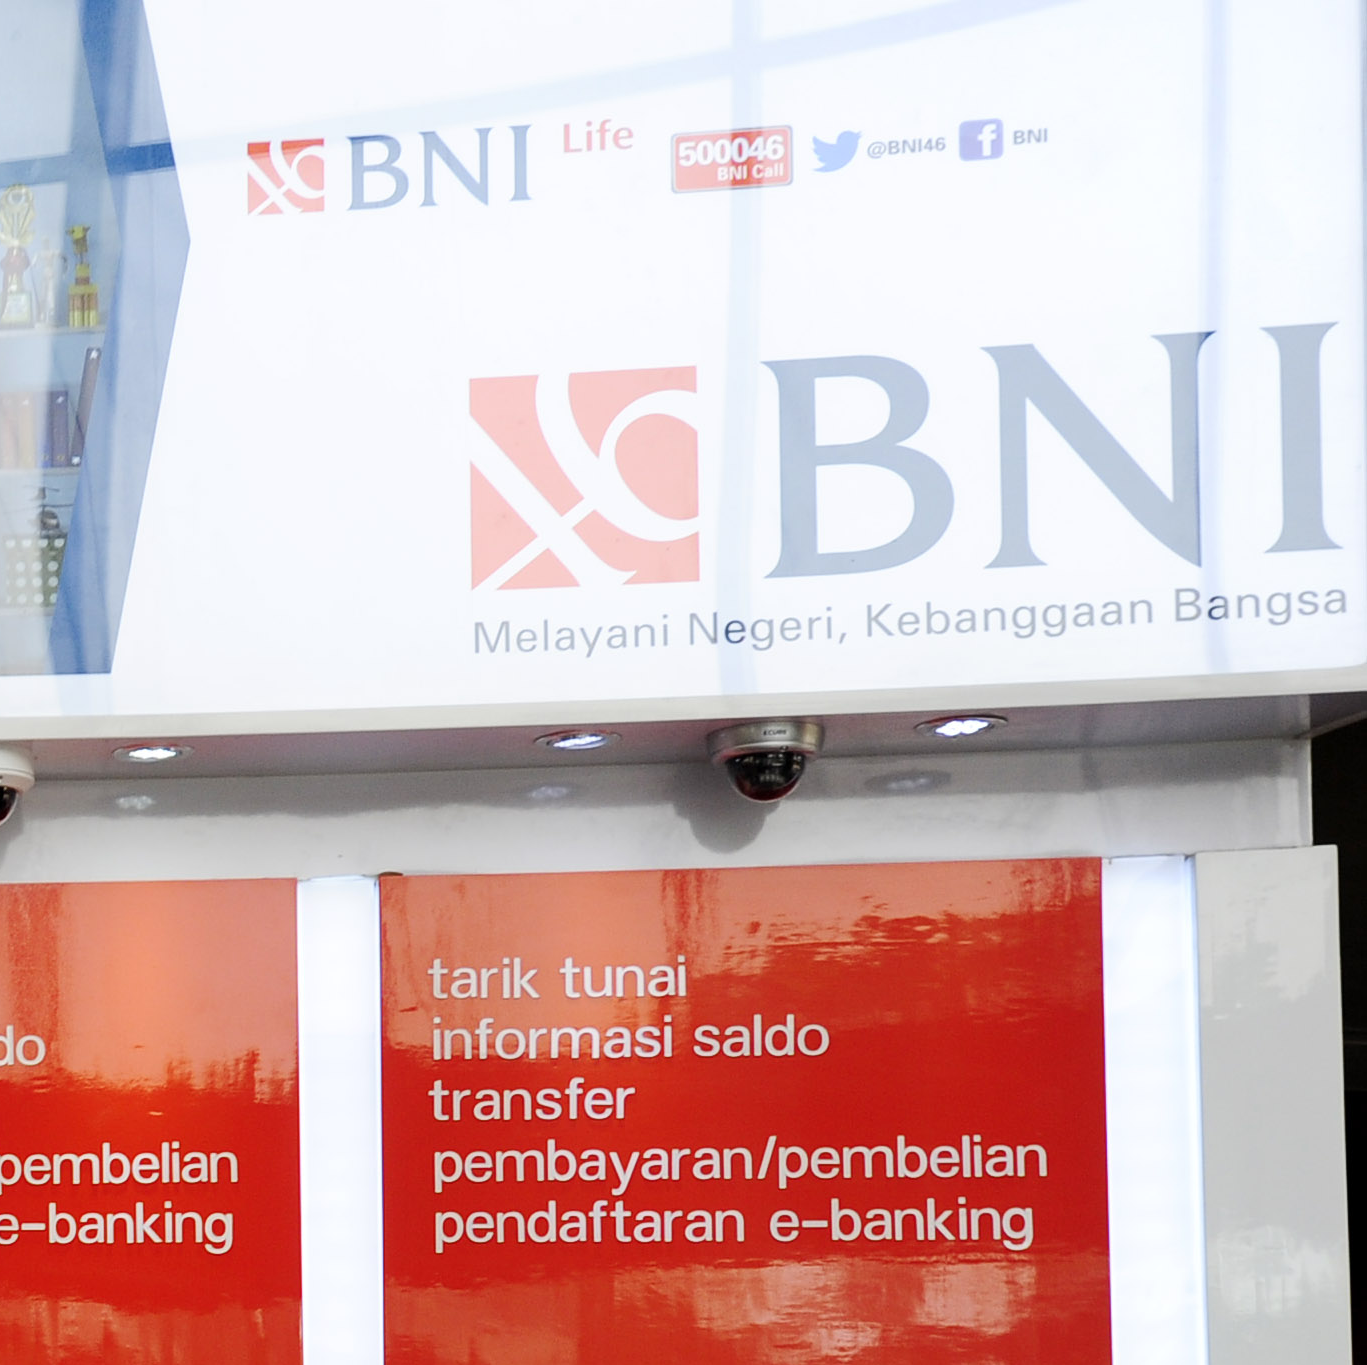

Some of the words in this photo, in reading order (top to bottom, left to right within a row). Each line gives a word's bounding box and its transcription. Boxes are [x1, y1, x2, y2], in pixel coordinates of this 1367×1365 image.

[677, 133, 785, 167] 500046
[866, 136, 947, 159] @BNI46
[1012, 128, 1049, 146] BNI
[345, 125, 531, 211] BNI
[564, 119, 633, 153] Life
[717, 165, 748, 183] BNI
[752, 163, 784, 180] Call
[760, 321, 1343, 579] BNI
[475, 619, 668, 658] Melayani
[689, 607, 846, 651] Negeri,
[867, 600, 1153, 639] Kebanggaan
[1175, 588, 1347, 626] Bangsa
[428, 957, 540, 999] tarik
[560, 952, 690, 1001] tunai
[433, 1013, 672, 1060] informasi
[694, 1014, 829, 1057] saldo
[428, 1077, 635, 1120] transfer
[434, 1135, 1047, 1195] pembayaran/pembelian
[435, 1200, 744, 1253] pendaftaran
[770, 1197, 1033, 1250] e-banking
